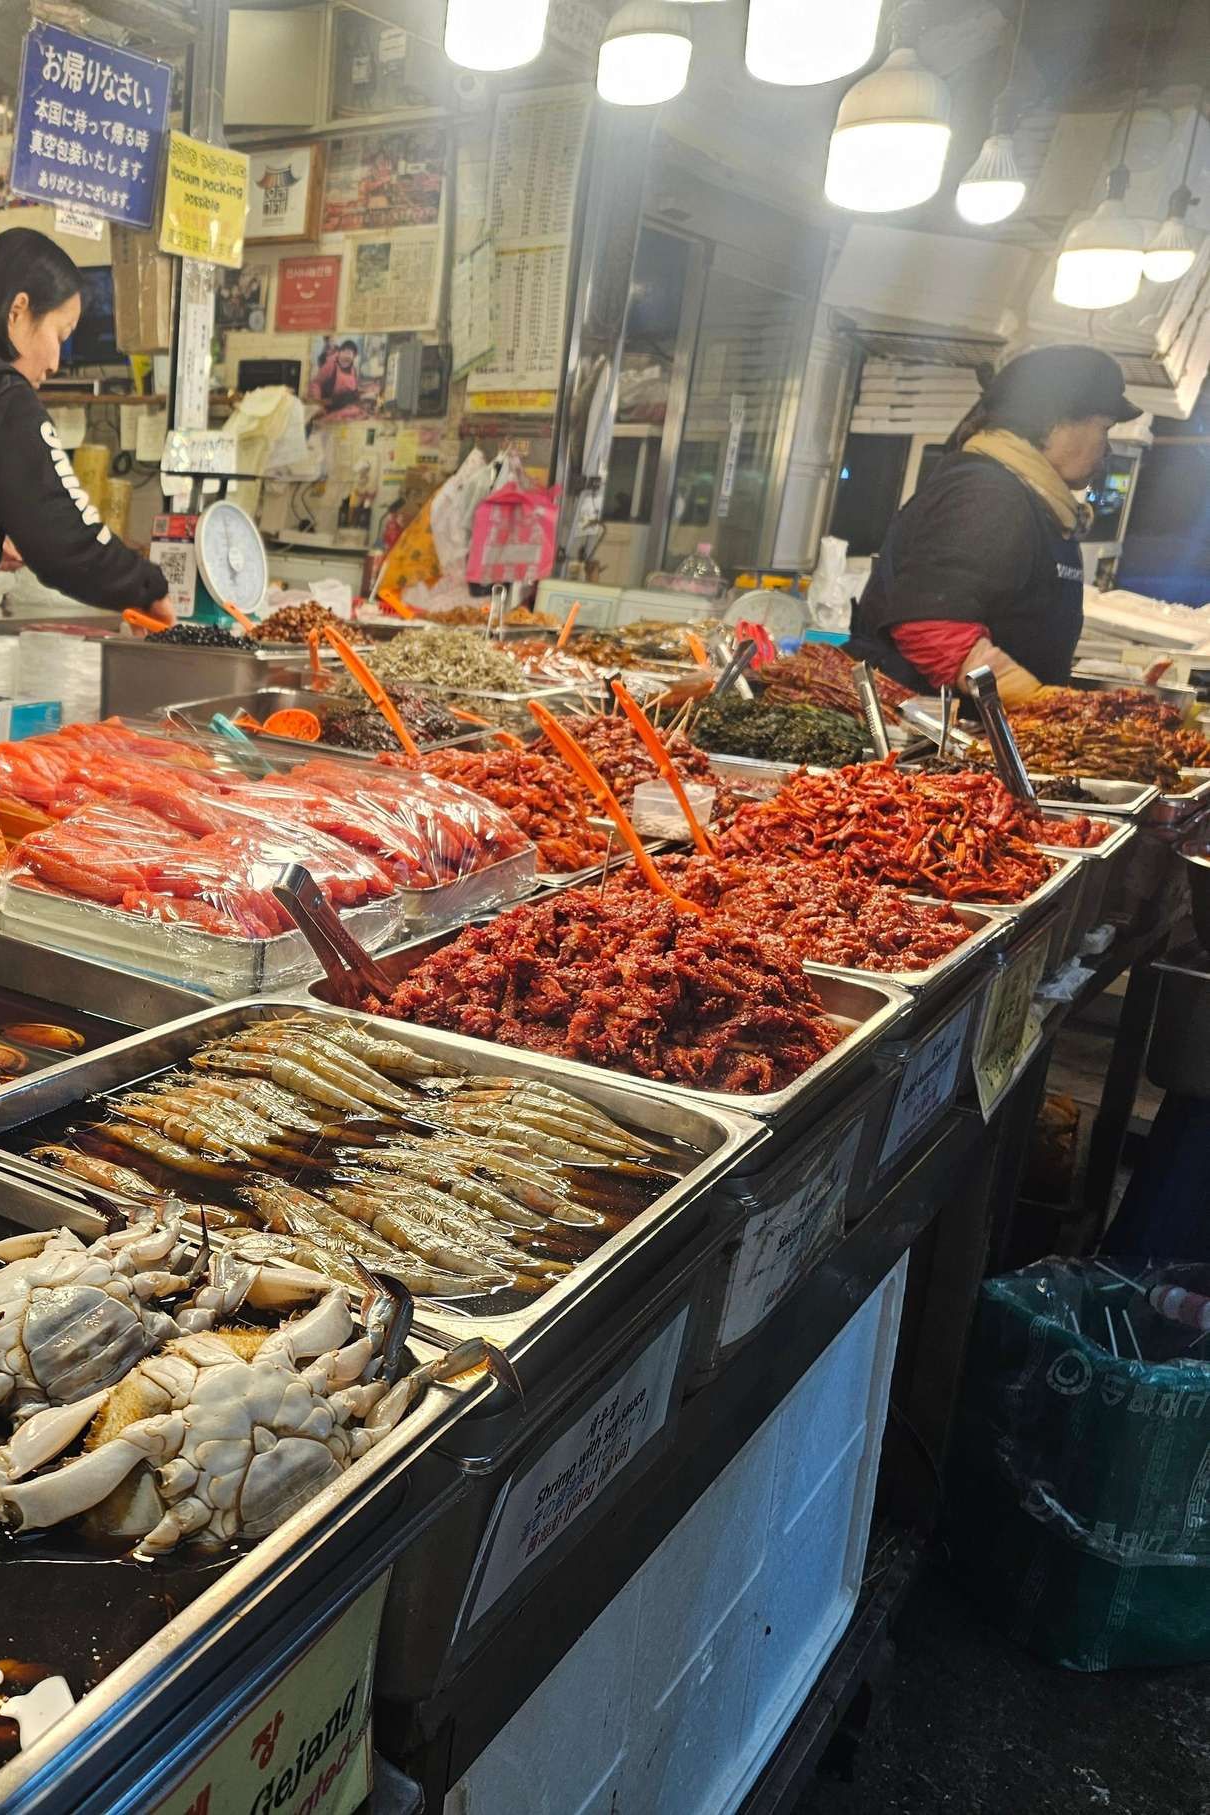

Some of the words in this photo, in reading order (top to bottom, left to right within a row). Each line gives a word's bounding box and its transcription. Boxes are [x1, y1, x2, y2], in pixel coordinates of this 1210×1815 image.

[535, 1462, 577, 1510] Shrimp
[579, 1434, 601, 1468] with
[602, 1415, 621, 1444] soy
[620, 1387, 646, 1422] sauce
[249, 1677, 358, 1815] Gejang
